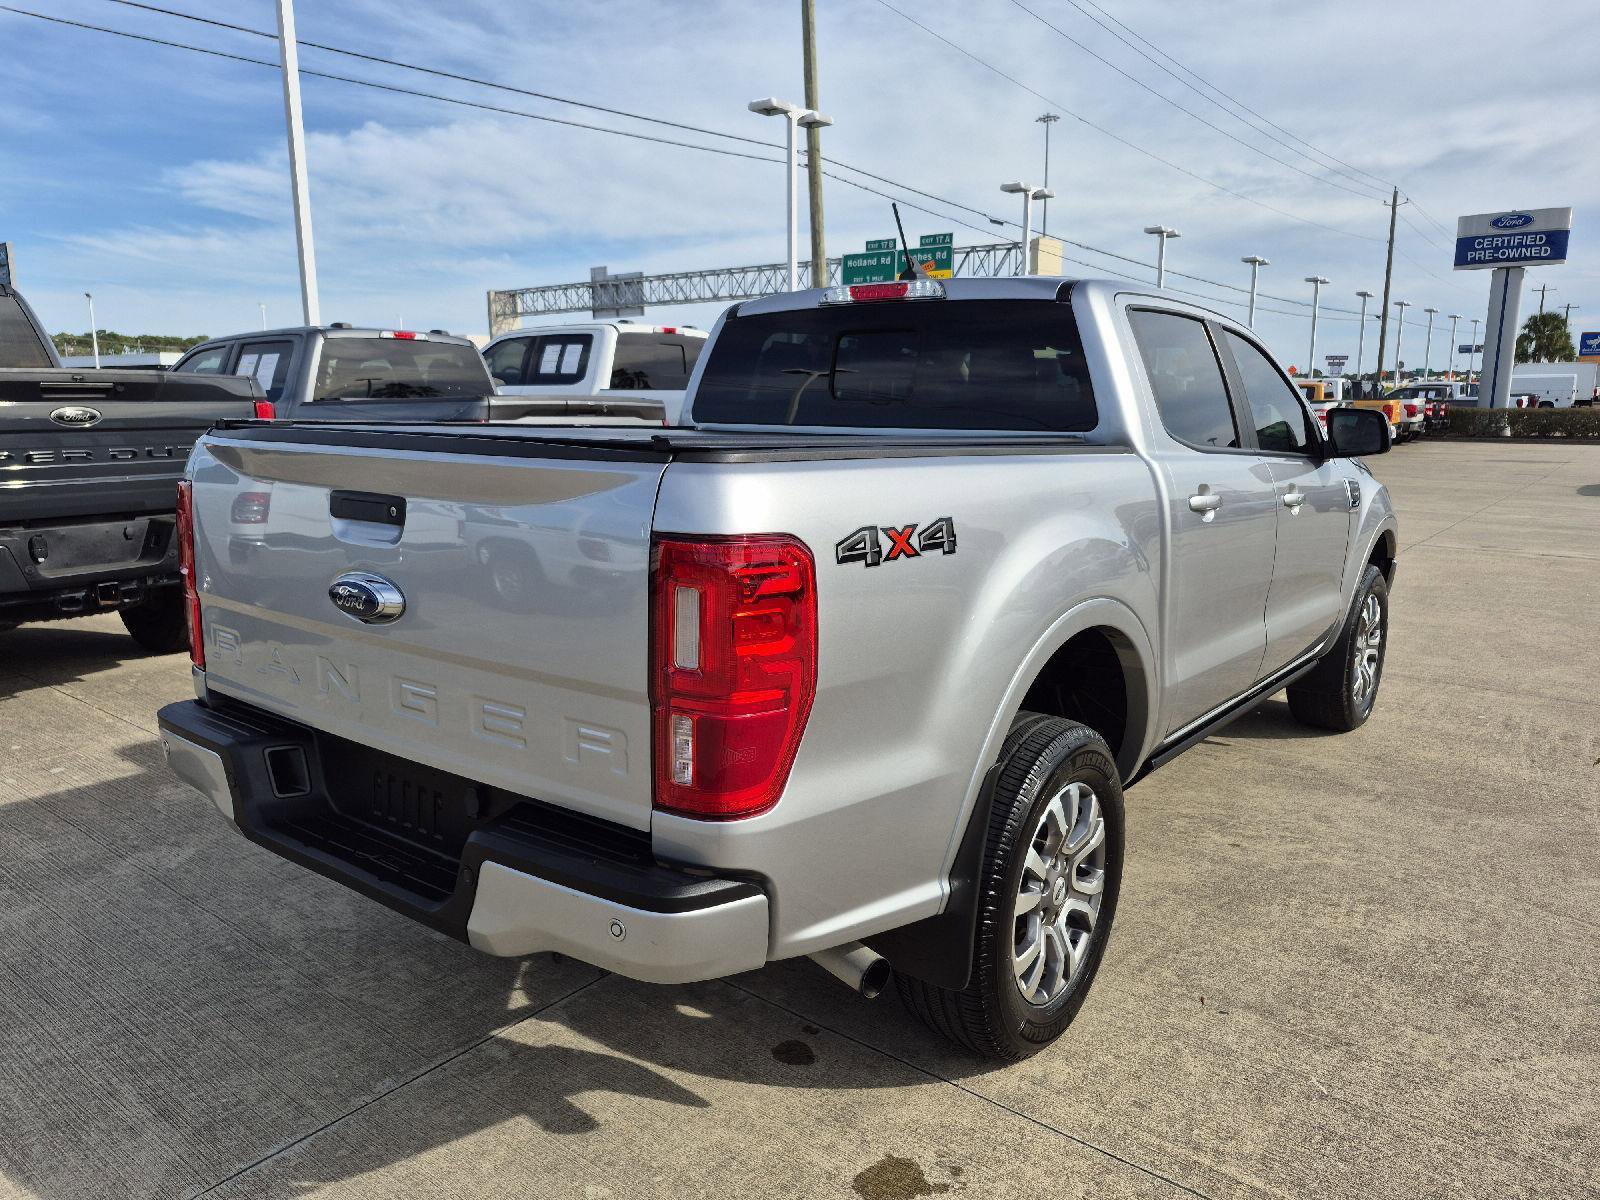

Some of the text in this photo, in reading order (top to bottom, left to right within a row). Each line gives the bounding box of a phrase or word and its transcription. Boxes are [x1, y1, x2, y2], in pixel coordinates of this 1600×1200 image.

[1498, 214, 1525, 227] Ford
[881, 241, 888, 249] 17
[935, 236, 944, 244] 17
[944, 235, 950, 243] A
[1474, 234, 1547, 249] CERTIFIED
[935, 251, 947, 260] Rd
[1467, 246, 1551, 261] PRE-OWNED
[847, 256, 891, 268] Holland Rd
[64, 410, 90, 421] Ford
[336, 585, 366, 611] Ford
[209, 622, 630, 775] RANGER
